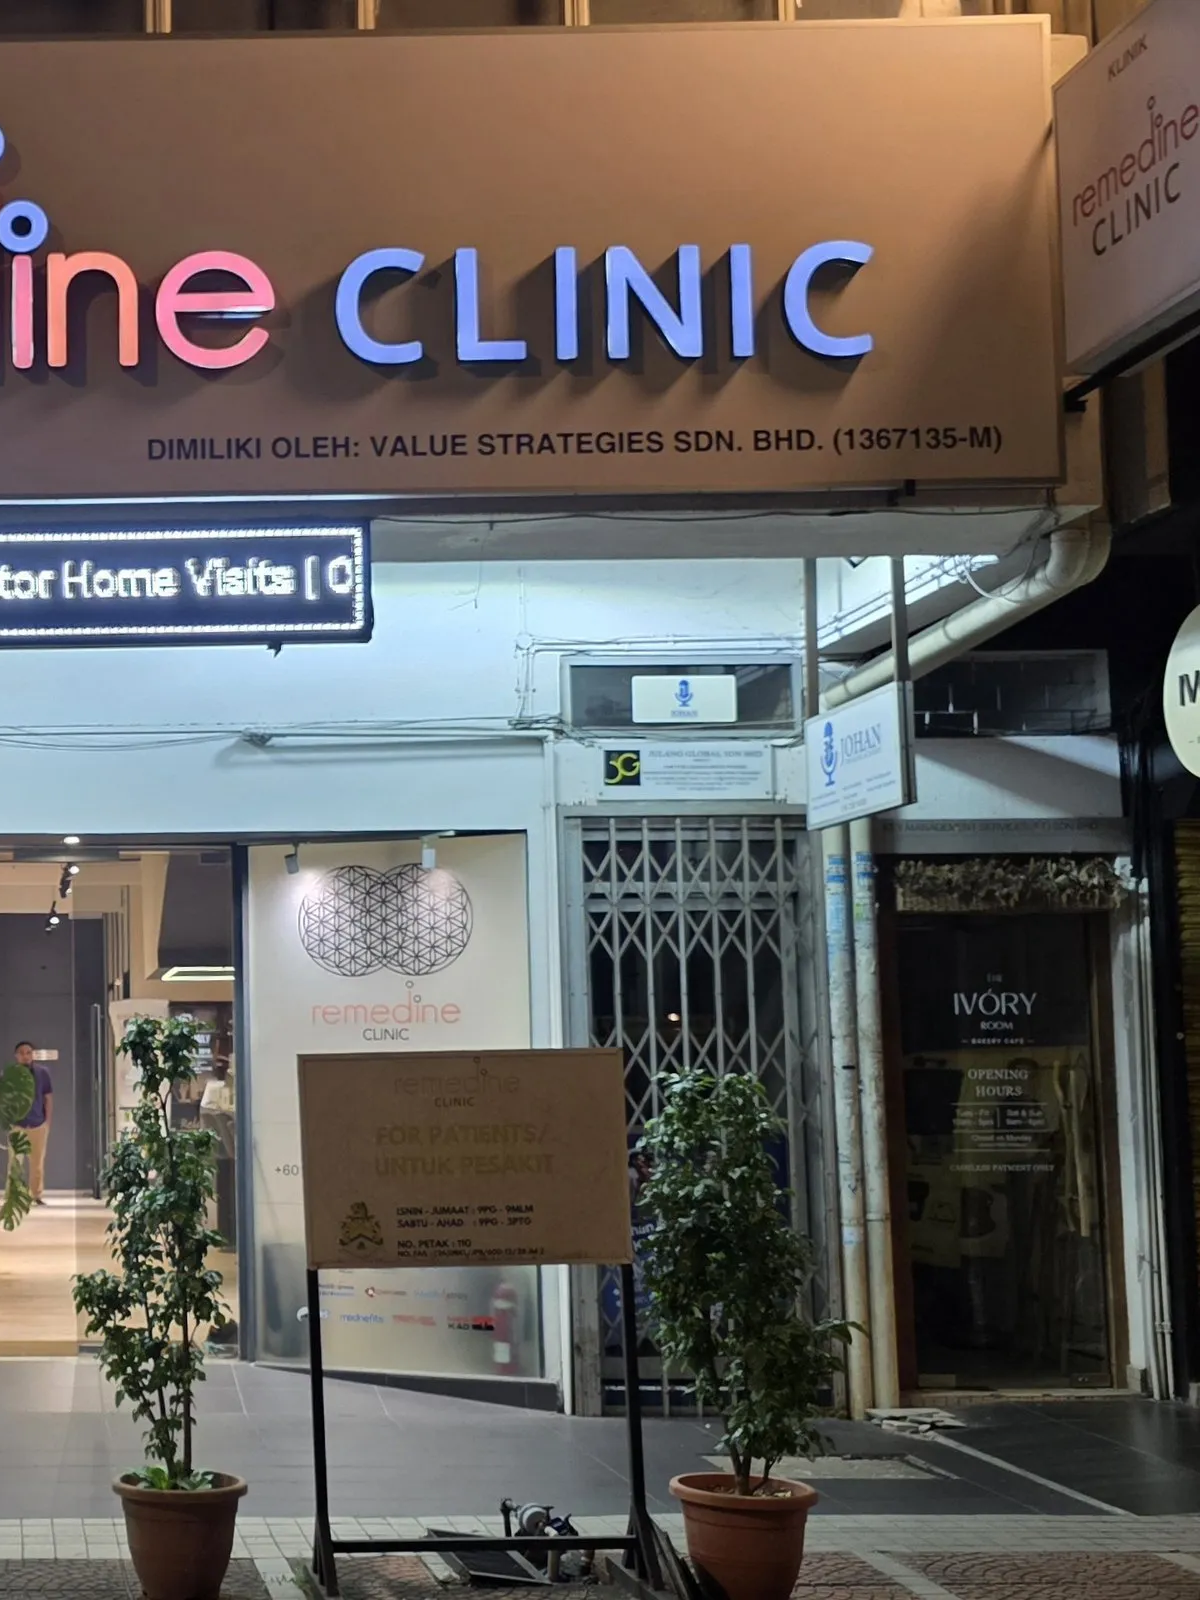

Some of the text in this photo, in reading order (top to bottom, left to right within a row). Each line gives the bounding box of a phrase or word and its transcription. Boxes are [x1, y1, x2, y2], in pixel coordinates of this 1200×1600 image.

[1107, 34, 1148, 81] KLINIK
[1072, 95, 1199, 227] remedine
[1092, 162, 1181, 256] CLINIC
[335, 240, 875, 364] CLINIC
[147, 426, 1003, 462] DIMILIKI OLEH: VALUE STRATEGIES SDN. BHD. (1367135-M)
[63, 560, 180, 599] Home
[185, 556, 296, 596] Visits
[840, 723, 881, 767] JOHAN
[311, 980, 462, 1026] remedine
[363, 1028, 410, 1041] CLINIC
[980, 1020, 1013, 1031] ROOM
[394, 1055, 520, 1096] remedine
[967, 1069, 1029, 1080] OPENING
[434, 1096, 475, 1108] CLINIC
[976, 1086, 1023, 1097] HOURS
[376, 1127, 421, 1146] FOR
[375, 1153, 555, 1177] UNTUK PESAKIT
[430, 1205, 469, 1215] JUMAAT
[397, 1219, 428, 1228] SABTU
[436, 1218, 464, 1227] AHAD
[418, 1239, 450, 1248] PETAK
